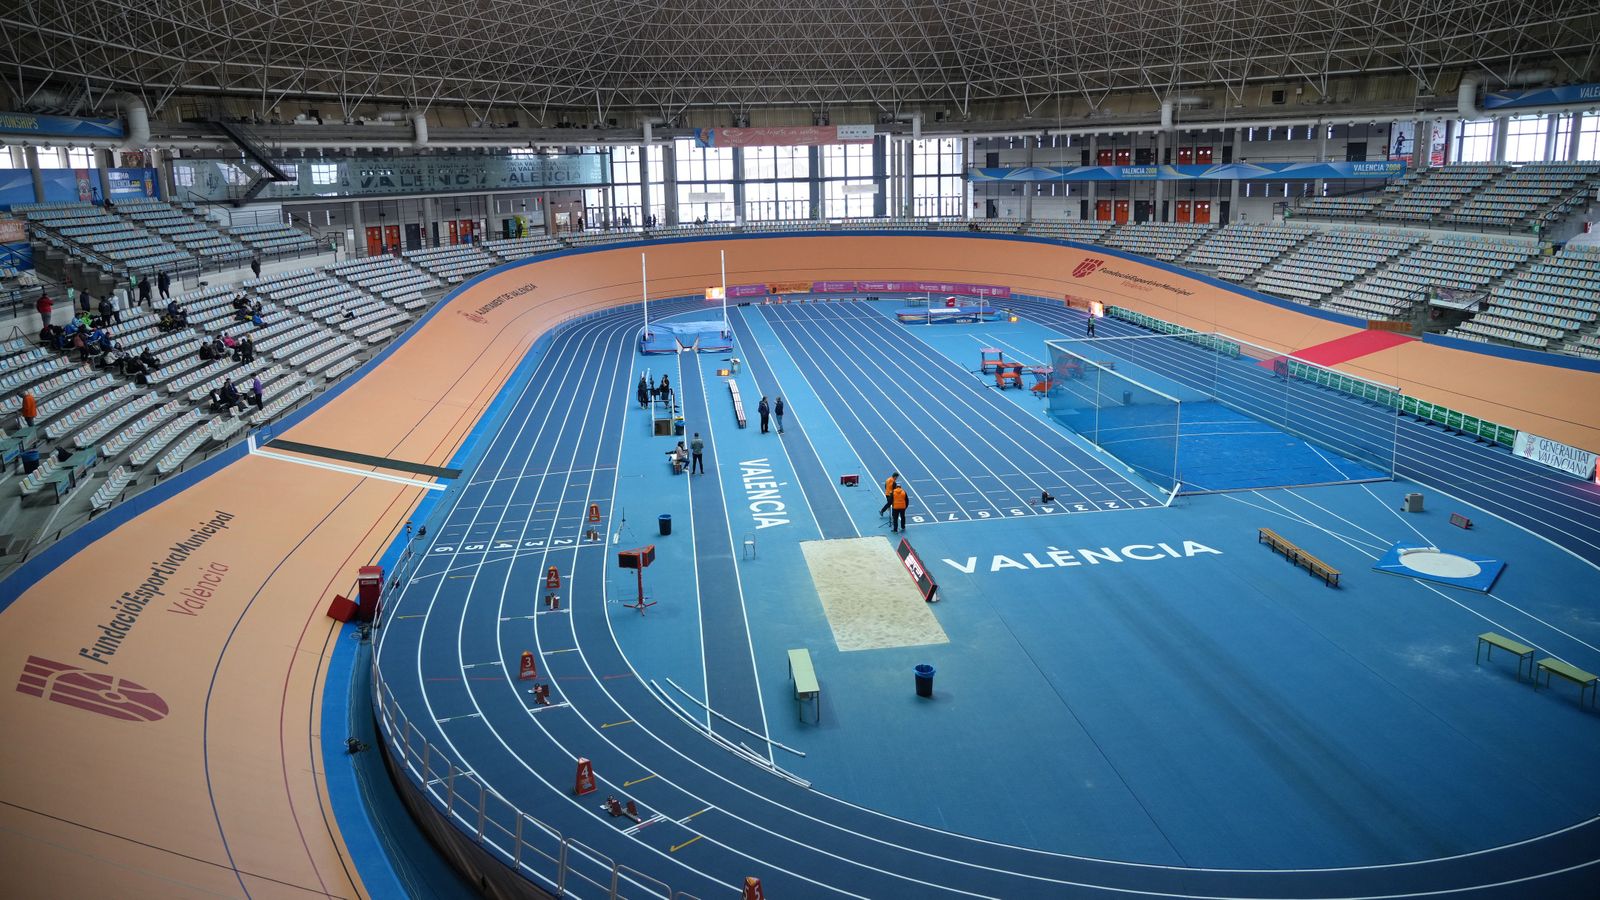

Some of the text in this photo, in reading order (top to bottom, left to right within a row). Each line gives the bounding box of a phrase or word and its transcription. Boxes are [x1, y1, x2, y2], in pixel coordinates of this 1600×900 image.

[1353, 163, 1385, 171] VALENCIA
[1540, 439, 1590, 464] GENERALITAT
[1539, 450, 1587, 477] VALENCIANA
[739, 458, 790, 529] VALÈNCIA
[1073, 504, 1089, 512] 3
[1104, 501, 1120, 509] 2
[1138, 499, 1150, 507] 1
[1010, 508, 1025, 516] 5
[1041, 506, 1055, 514] 4
[911, 515, 925, 523] 8
[948, 513, 959, 521] 7
[941, 540, 1224, 574] VALÈNCIA
[550, 571, 556, 581] 2
[79, 510, 235, 665] FundacióEsportivaMunicipal
[166, 561, 229, 617] València
[525, 656, 531, 668] 3
[581, 764, 589, 778] 4
